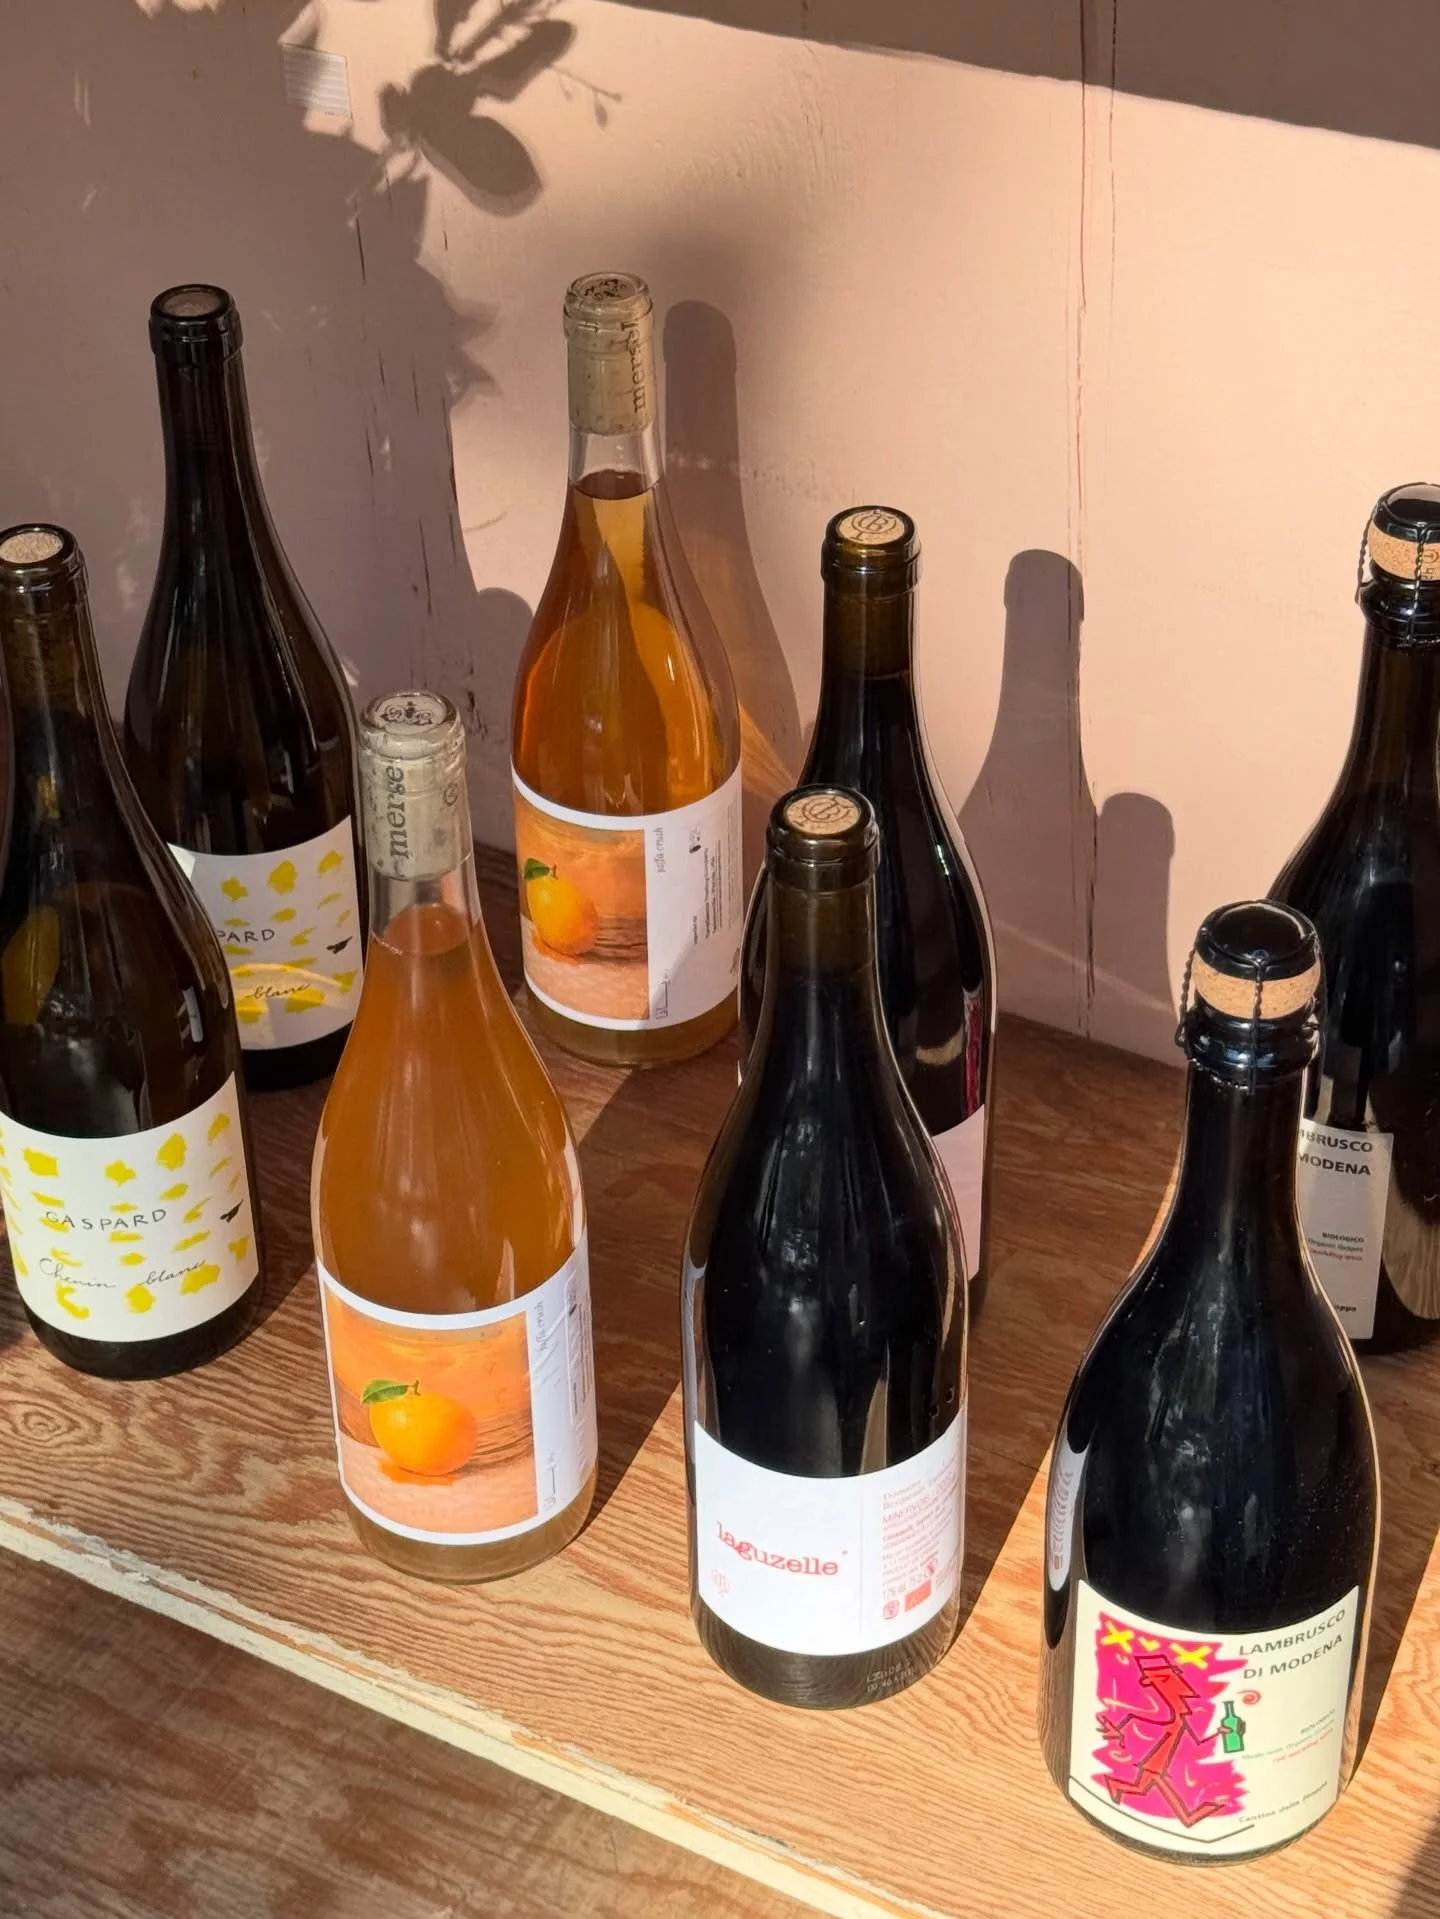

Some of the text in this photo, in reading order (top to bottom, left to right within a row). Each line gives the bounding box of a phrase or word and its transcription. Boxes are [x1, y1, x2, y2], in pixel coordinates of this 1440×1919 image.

[1298, 1153, 1371, 1176] MODENA
[45, 1208, 167, 1231] GASPARD
[39, 1258, 206, 1288] Chenin blanc
[716, 1520, 839, 1576] laguzelle
[1239, 1608, 1346, 1657] LAMBRUSCO
[1243, 1633, 1344, 1680] DI MODENA
